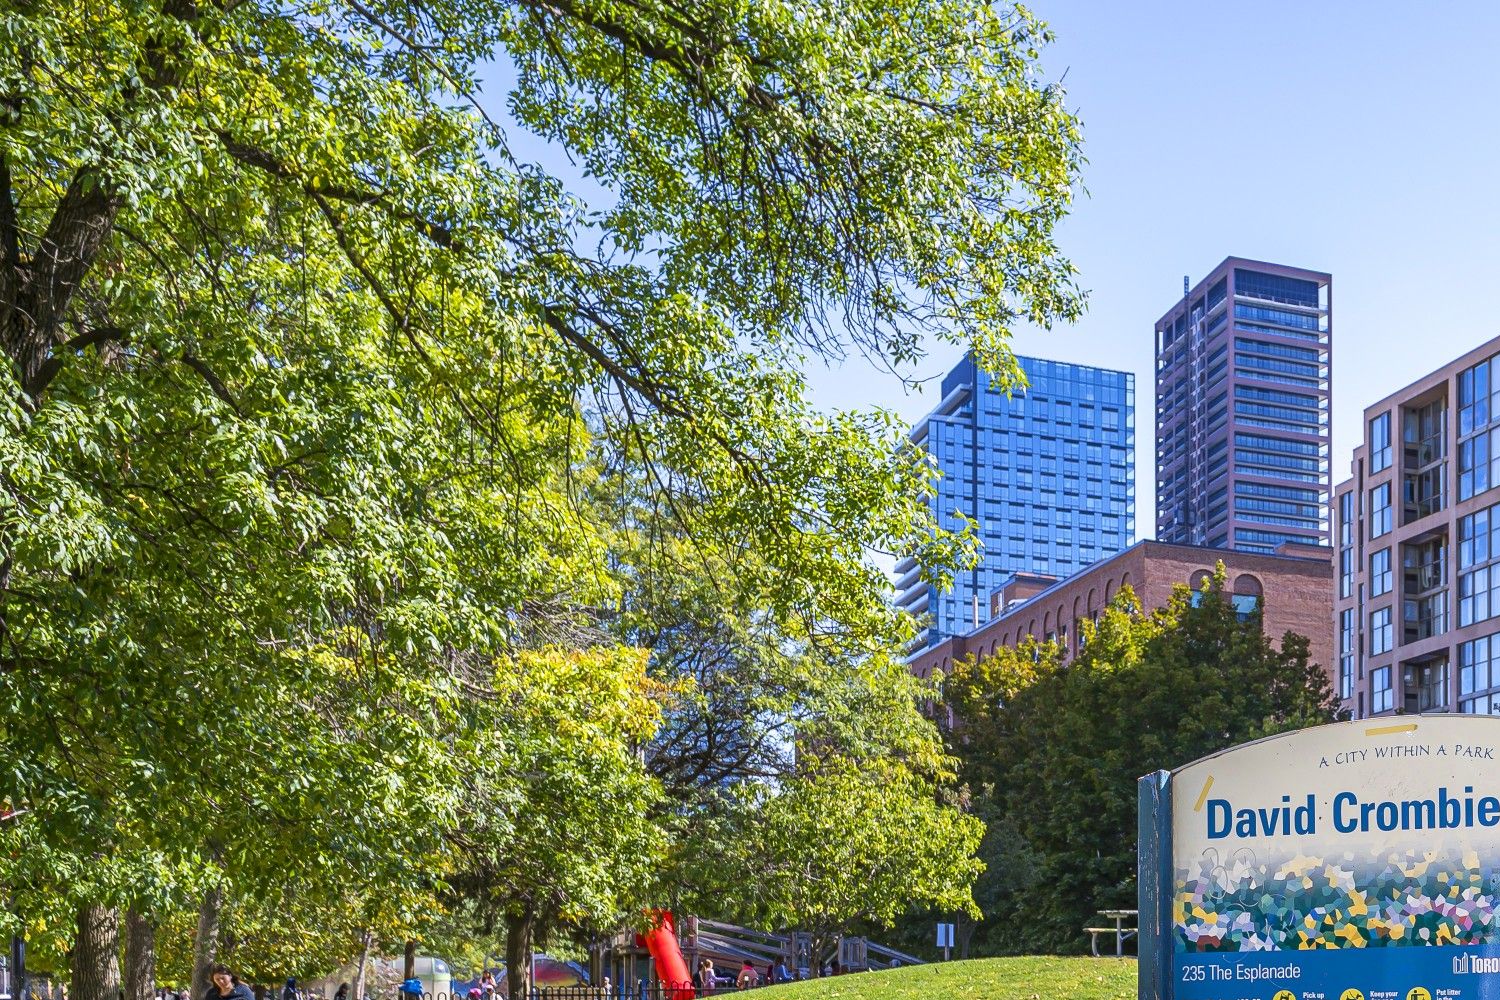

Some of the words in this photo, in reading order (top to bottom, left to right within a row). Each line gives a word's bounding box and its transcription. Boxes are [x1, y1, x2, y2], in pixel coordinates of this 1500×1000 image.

[1319, 757, 1329, 768] A
[1335, 749, 1368, 765] CITY
[1374, 745, 1430, 759] WITHIN
[1436, 745, 1447, 756] A
[1454, 744, 1495, 760] PARK
[1207, 794, 1316, 839] David
[1333, 785, 1500, 834] Crombie
[1182, 965, 1206, 982] 235
[1208, 964, 1232, 981] The
[1236, 963, 1301, 983] Esplanade
